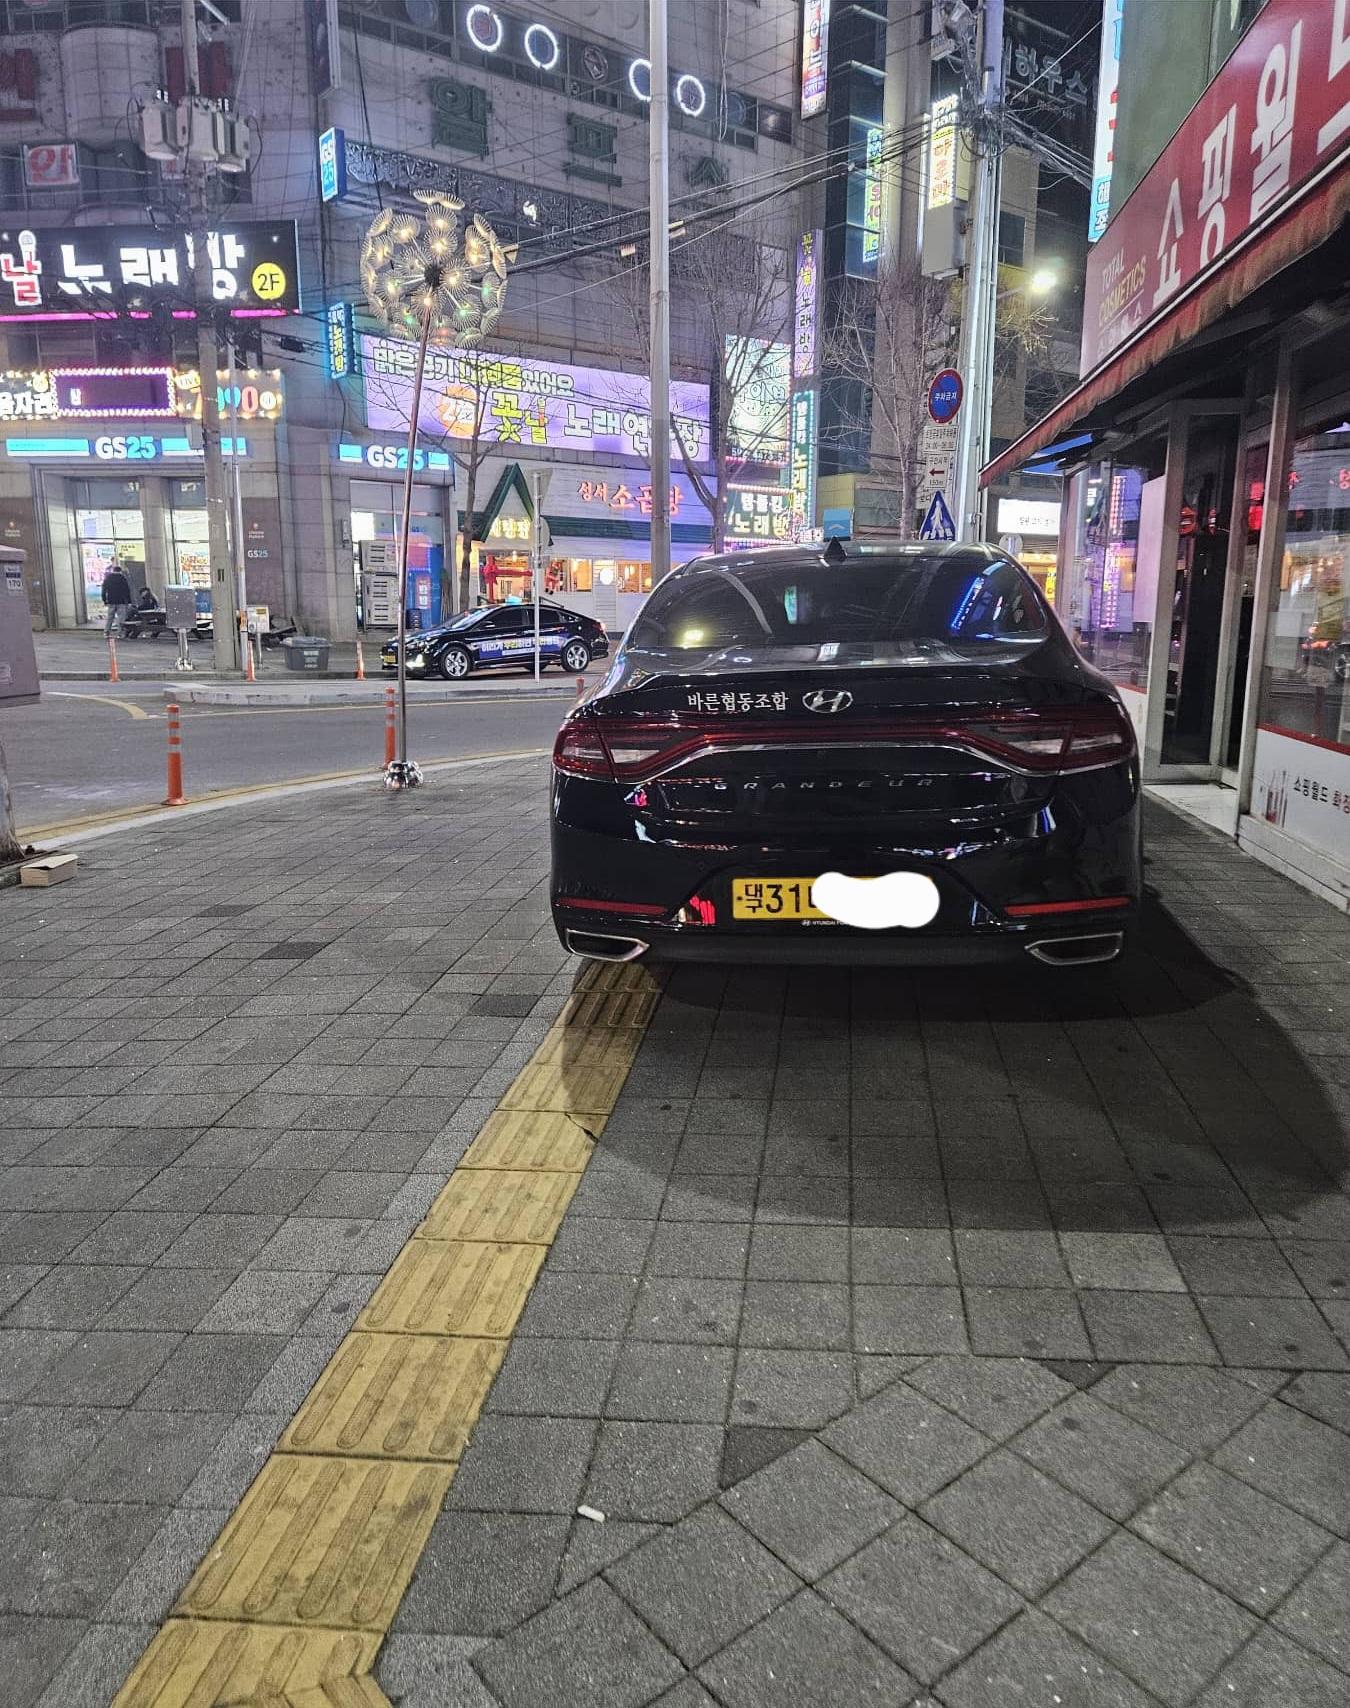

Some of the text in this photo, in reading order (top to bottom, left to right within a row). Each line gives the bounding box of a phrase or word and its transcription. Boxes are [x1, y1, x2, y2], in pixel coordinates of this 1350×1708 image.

[1102, 247, 1125, 292] TOTAL
[257, 273, 281, 292] 2F
[1098, 255, 1147, 327] COSMETICS
[799, 293, 813, 353] 노래방
[563, 403, 704, 459] 노래연장
[94, 436, 156, 459] GS25
[366, 446, 424, 470] GS25
[687, 691, 787, 713] 바른협동조합
[713, 778, 935, 791] GRANDEUR
